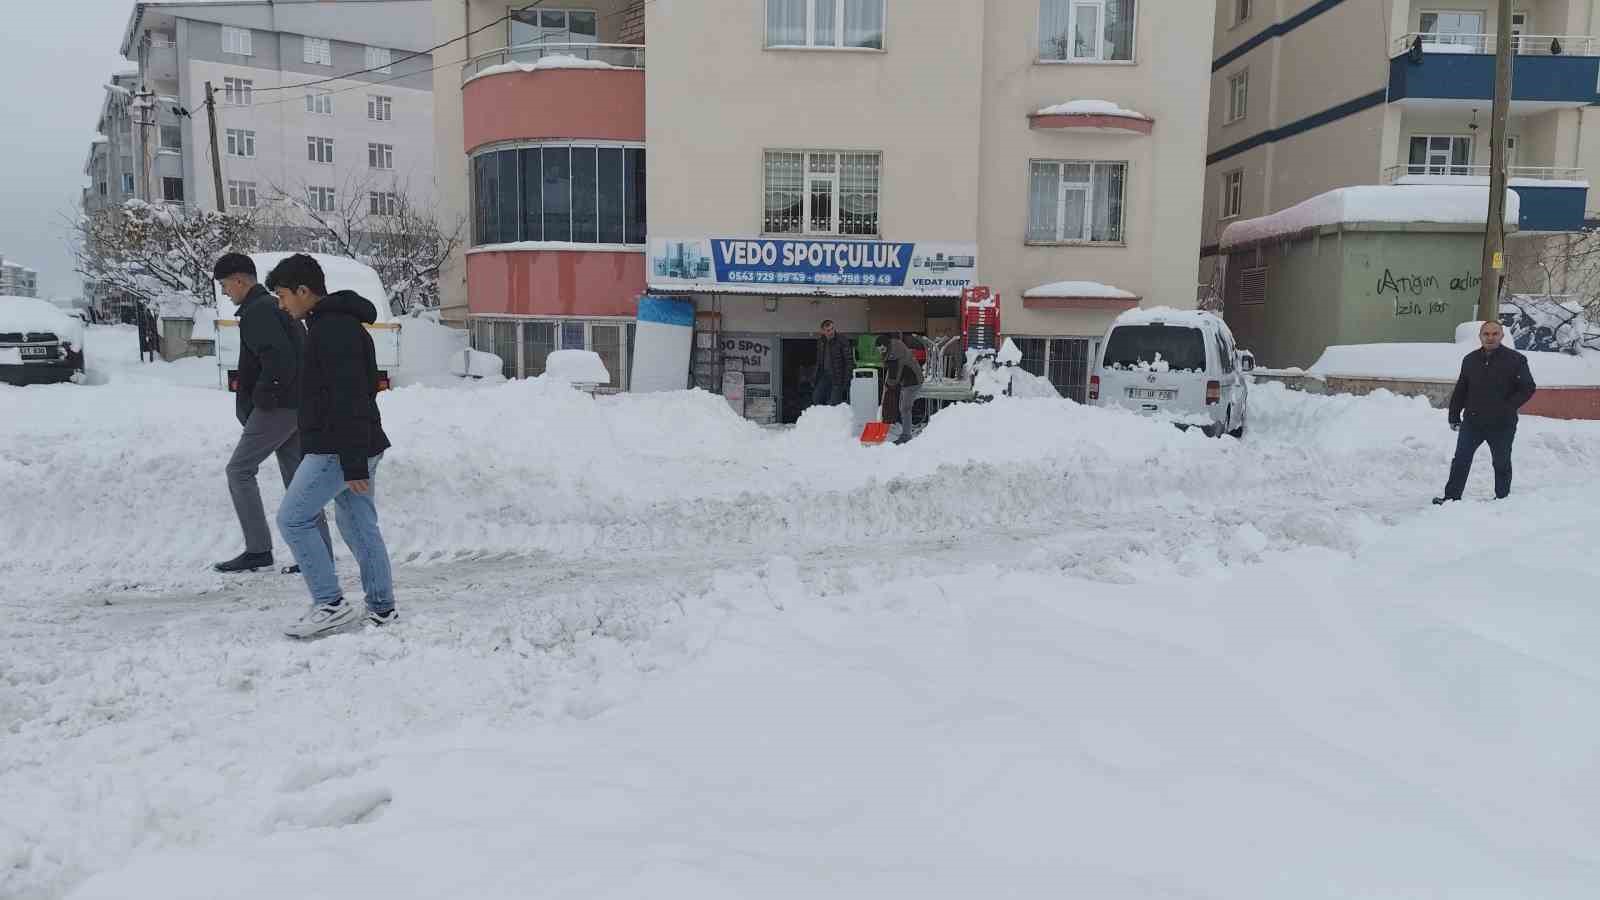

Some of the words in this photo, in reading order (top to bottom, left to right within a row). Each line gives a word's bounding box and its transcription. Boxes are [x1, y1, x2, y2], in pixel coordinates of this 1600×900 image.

[720, 240, 777, 265] VEDO
[782, 242, 902, 274] SPOTÇULUK
[738, 340, 770, 356] SPOT
